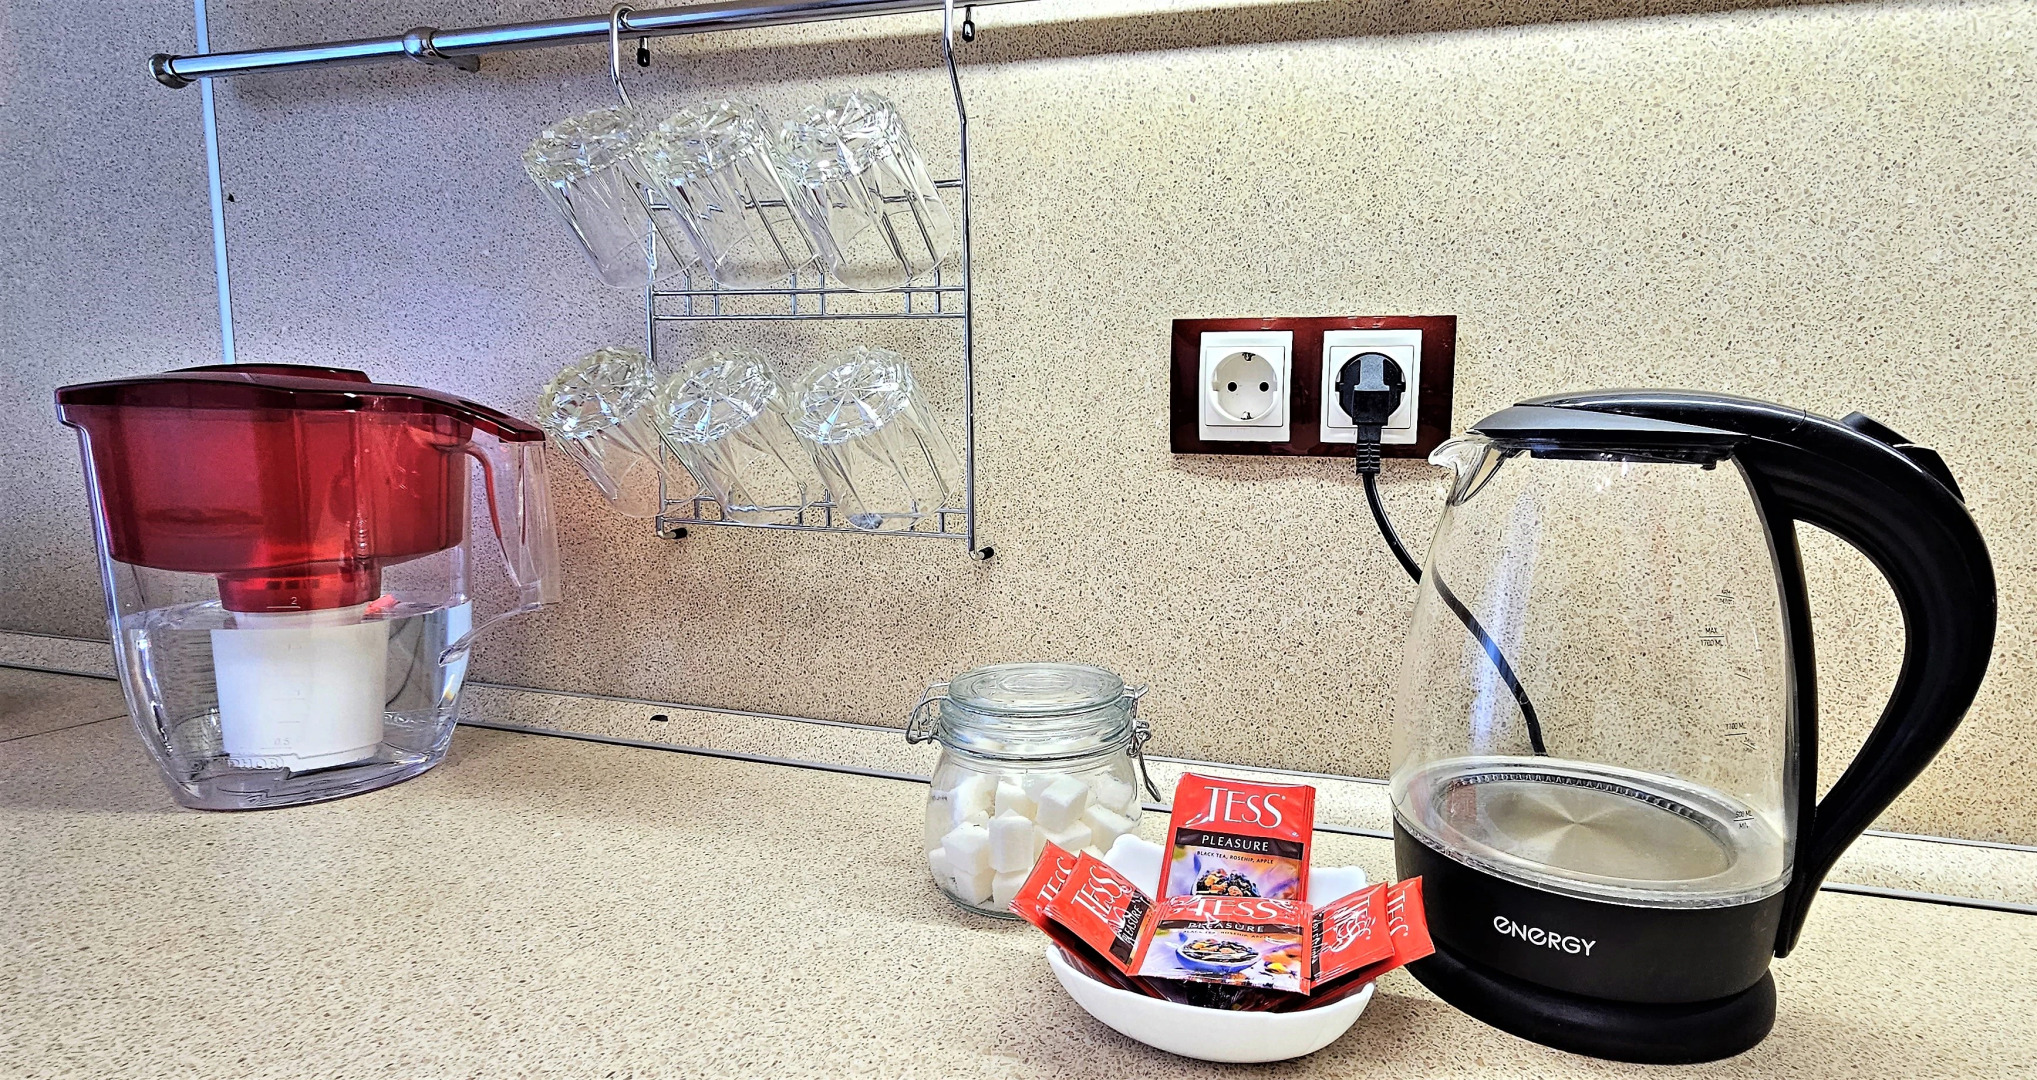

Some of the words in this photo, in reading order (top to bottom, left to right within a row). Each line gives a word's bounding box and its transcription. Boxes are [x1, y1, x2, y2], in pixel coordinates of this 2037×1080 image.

[291, 596, 298, 605] 2
[1203, 785, 1283, 829] TESS
[1201, 834, 1269, 852] PLEASURE
[1216, 851, 1229, 860] TEA,
[1229, 854, 1255, 863] ROSEHIP,
[1256, 857, 1274, 865] APPLE
[1071, 865, 1123, 923] TESS
[1193, 897, 1278, 920] TESS
